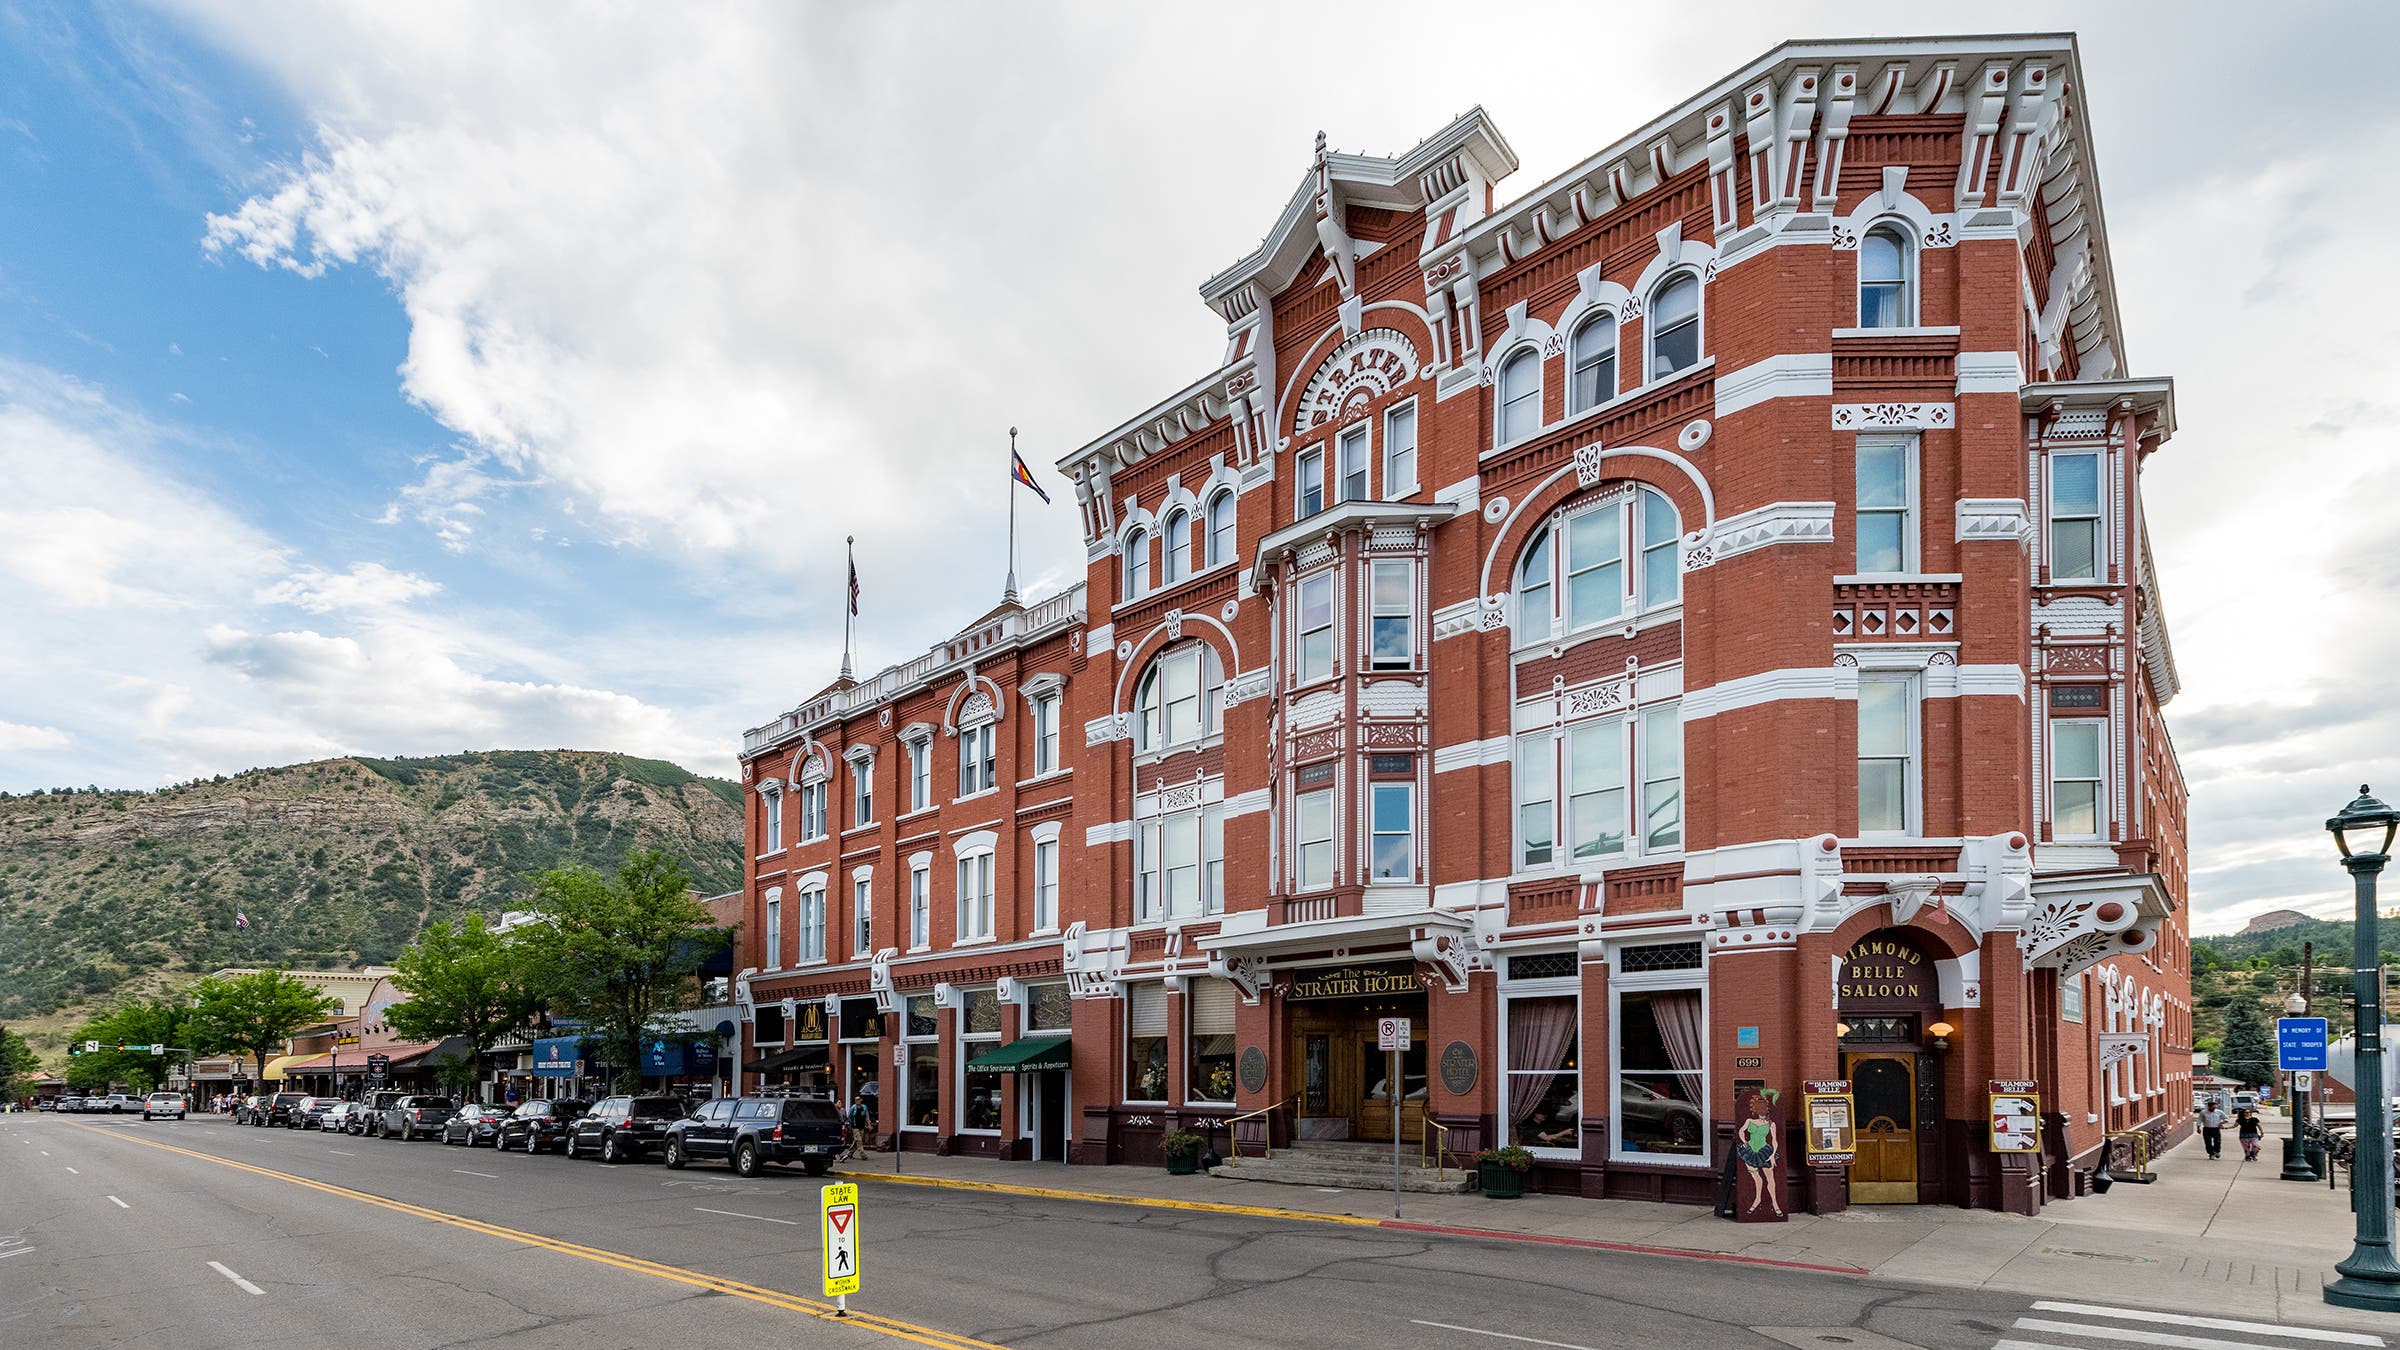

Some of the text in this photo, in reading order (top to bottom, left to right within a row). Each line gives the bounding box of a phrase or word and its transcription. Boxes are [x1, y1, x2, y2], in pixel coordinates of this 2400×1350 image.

[1311, 348, 1407, 426] STRATER
[1342, 968, 1361, 979] The
[1852, 966, 1905, 979] BELLE
[1295, 975, 1418, 997] STRATER HOTEL
[1841, 984, 1919, 997] SALOON
[1021, 1063, 1037, 1071] Spirits
[1739, 1058, 1759, 1067] 699
[830, 1186, 851, 1195] STATE
[834, 1195, 848, 1203] LAW
[828, 1284, 856, 1294] CROSSWALK
